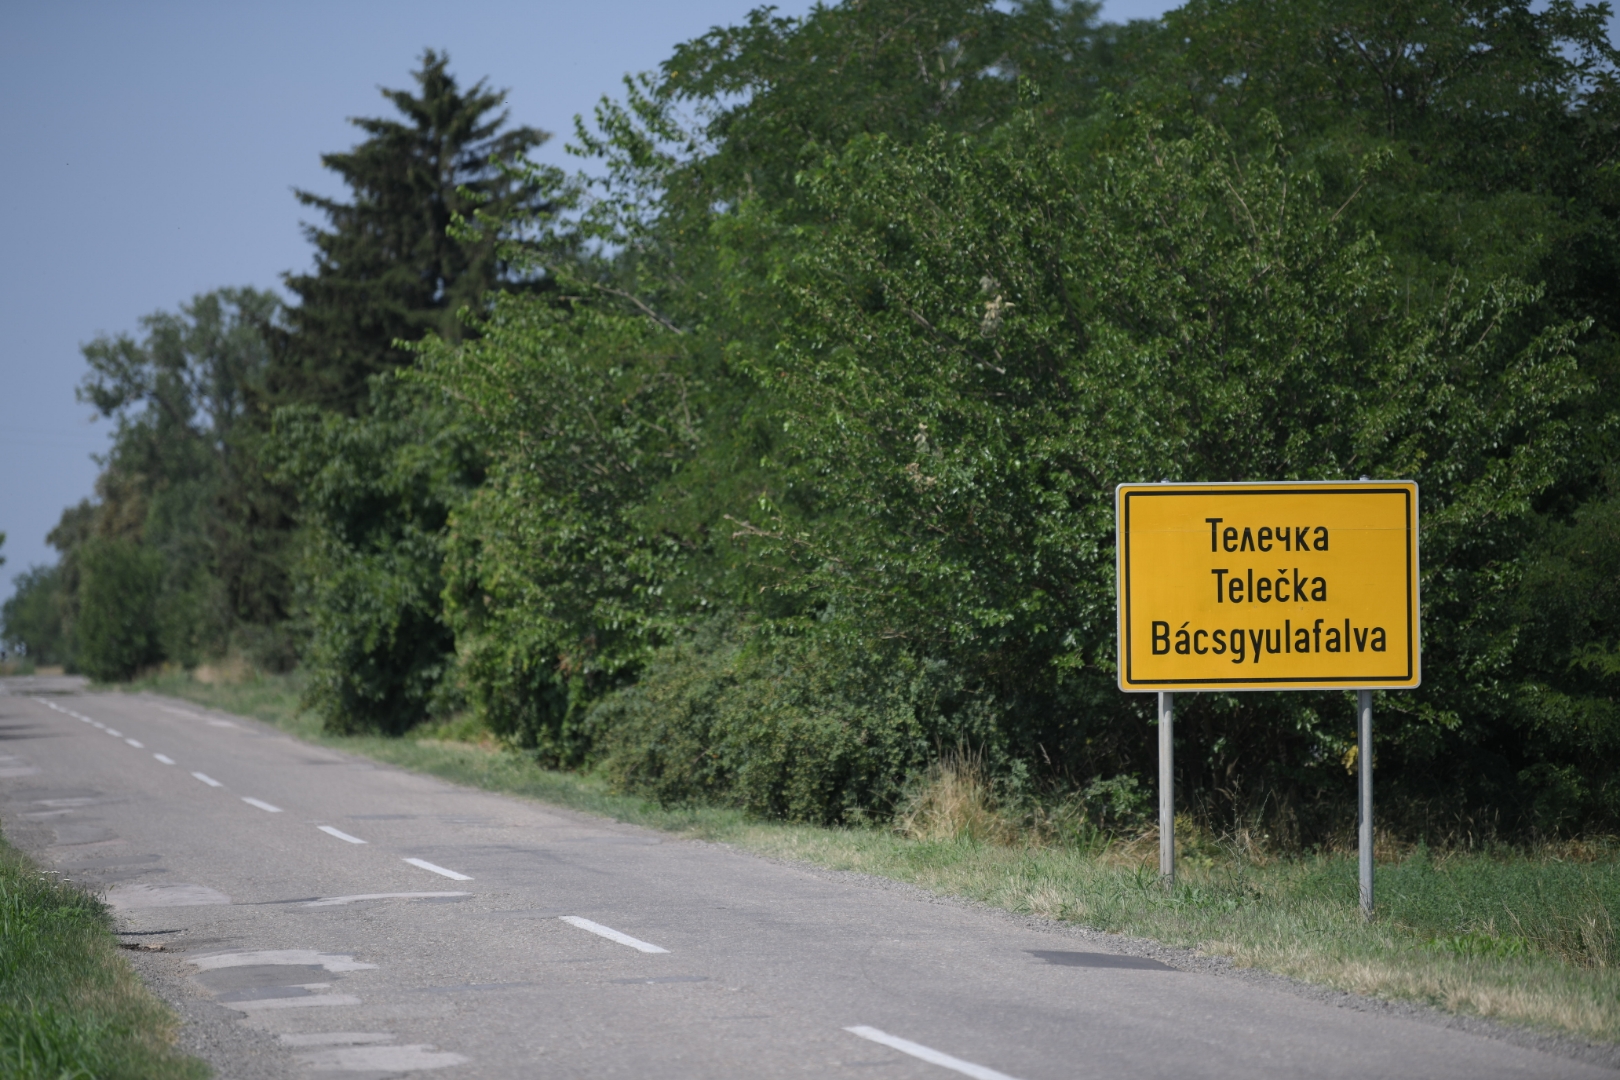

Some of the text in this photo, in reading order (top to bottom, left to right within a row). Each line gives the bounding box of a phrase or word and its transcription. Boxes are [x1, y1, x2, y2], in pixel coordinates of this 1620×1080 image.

[1205, 517, 1329, 553] Телечка
[1211, 567, 1327, 604] Telečka
[1151, 618, 1387, 665] Bácsgyulafalva
